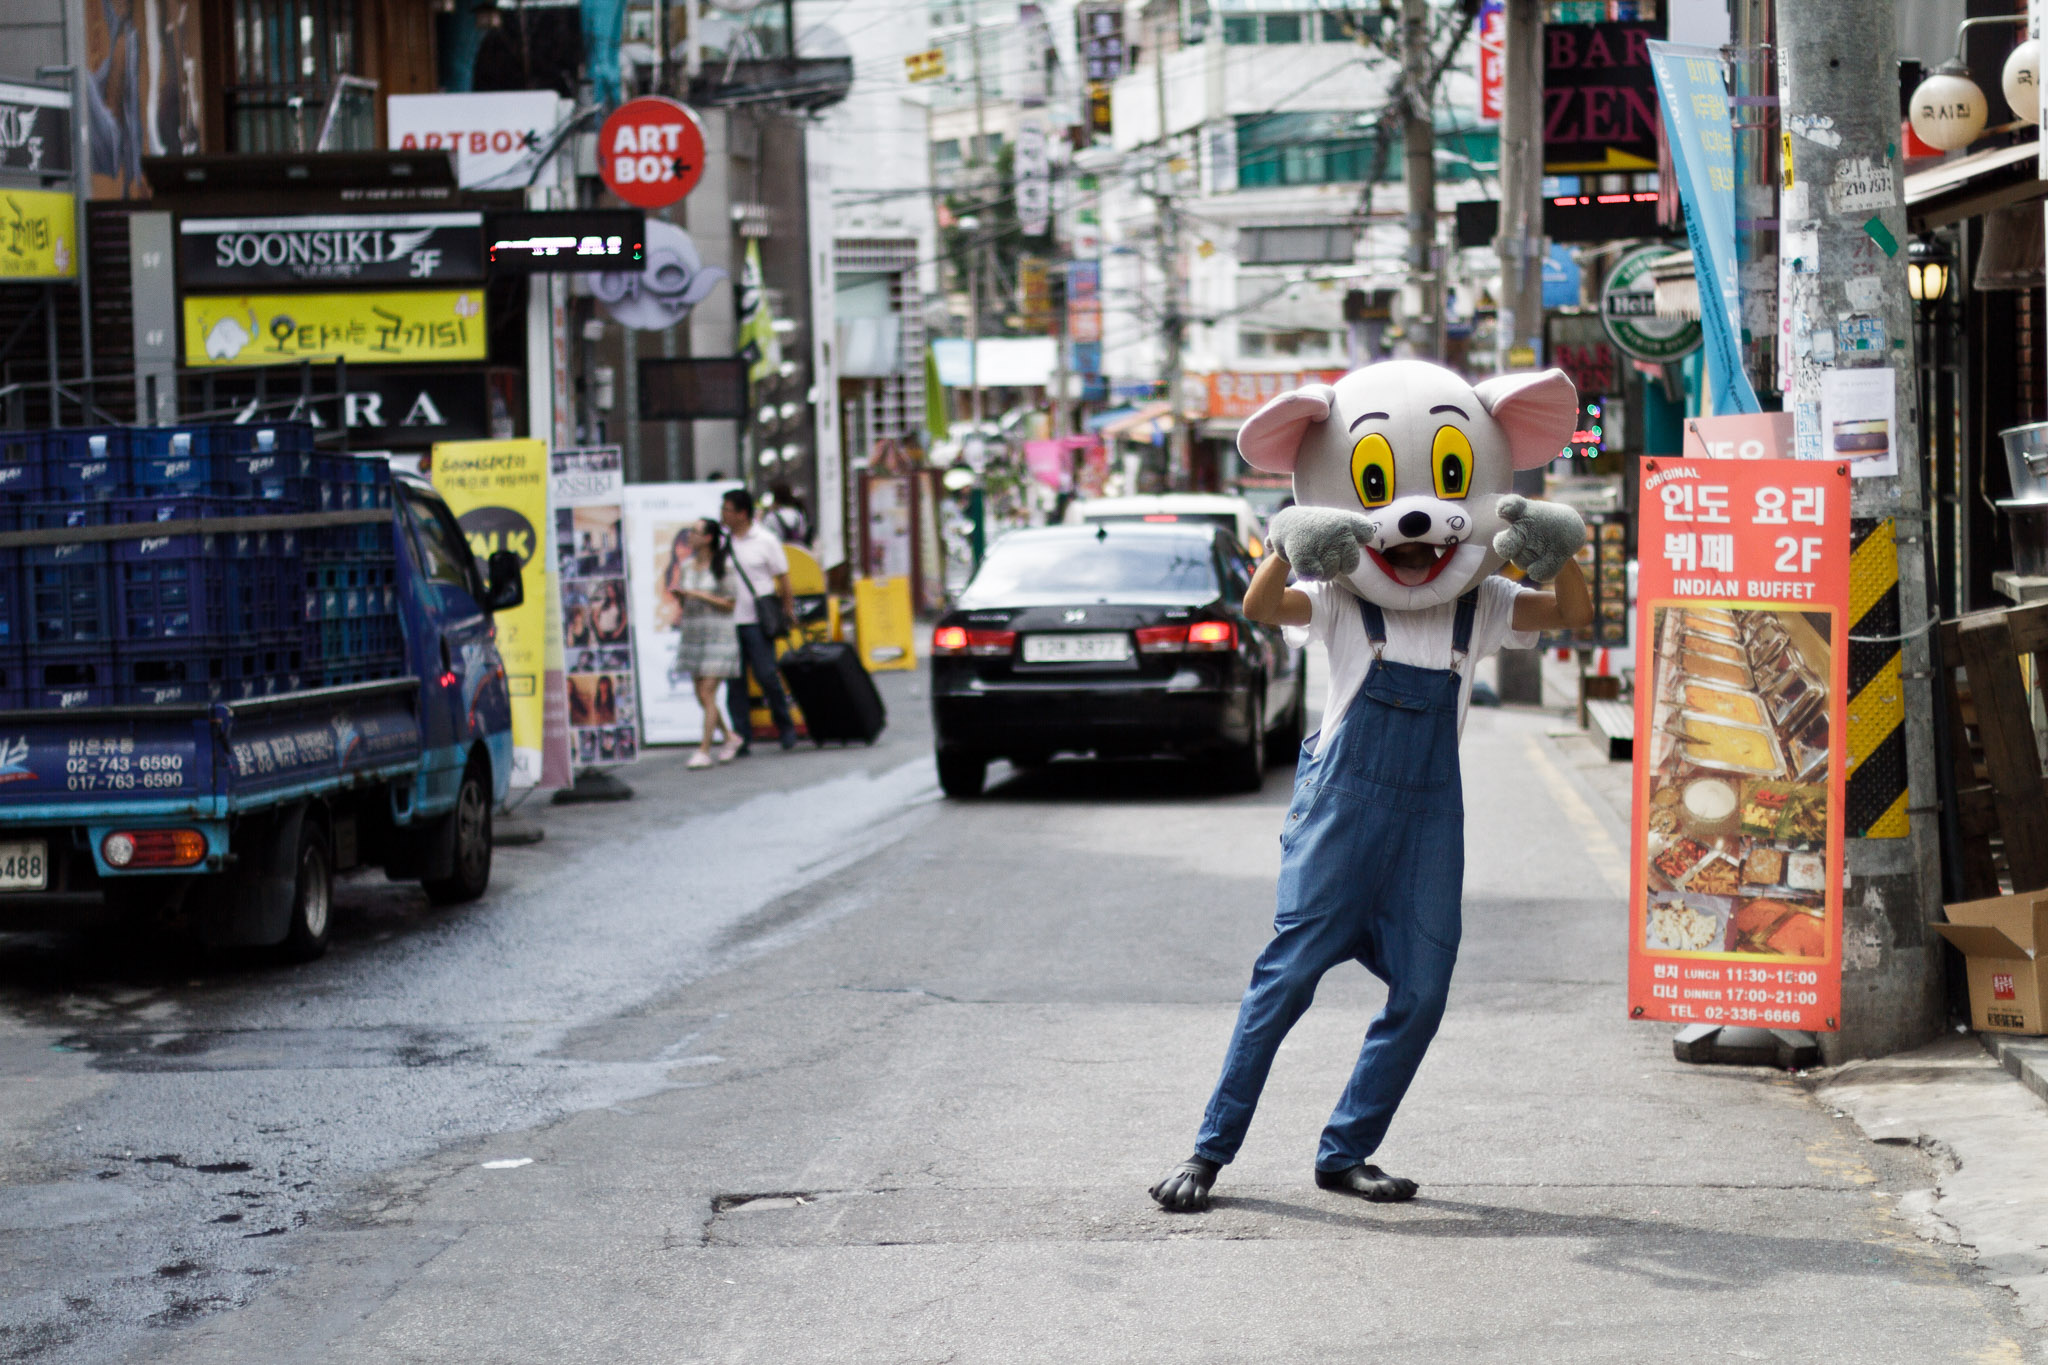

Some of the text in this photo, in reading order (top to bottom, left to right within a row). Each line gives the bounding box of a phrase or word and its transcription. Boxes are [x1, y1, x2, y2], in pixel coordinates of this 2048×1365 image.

[1549, 29, 1652, 68] BAR
[1543, 86, 1659, 143] ZEN
[614, 124, 684, 154] ART
[614, 156, 676, 184] BOX
[216, 231, 385, 268] SOONSIKI
[409, 249, 443, 279] 5F
[1645, 467, 1701, 491] ORIGINAL
[1660, 484, 1826, 526] 인도 요리
[1663, 532, 1823, 573] 뷔페 2F
[1673, 578, 1816, 600] INDIAN BUFFET
[66, 754, 183, 773] 02-743-6590
[67, 772, 184, 791] 017-763-6590
[1684, 969, 1720, 981] LUNCH
[1652, 984, 1818, 1005] 디너 DINNER 17:00~21:00
[1668, 1004, 1801, 1023] TEL. 02-336-6666
